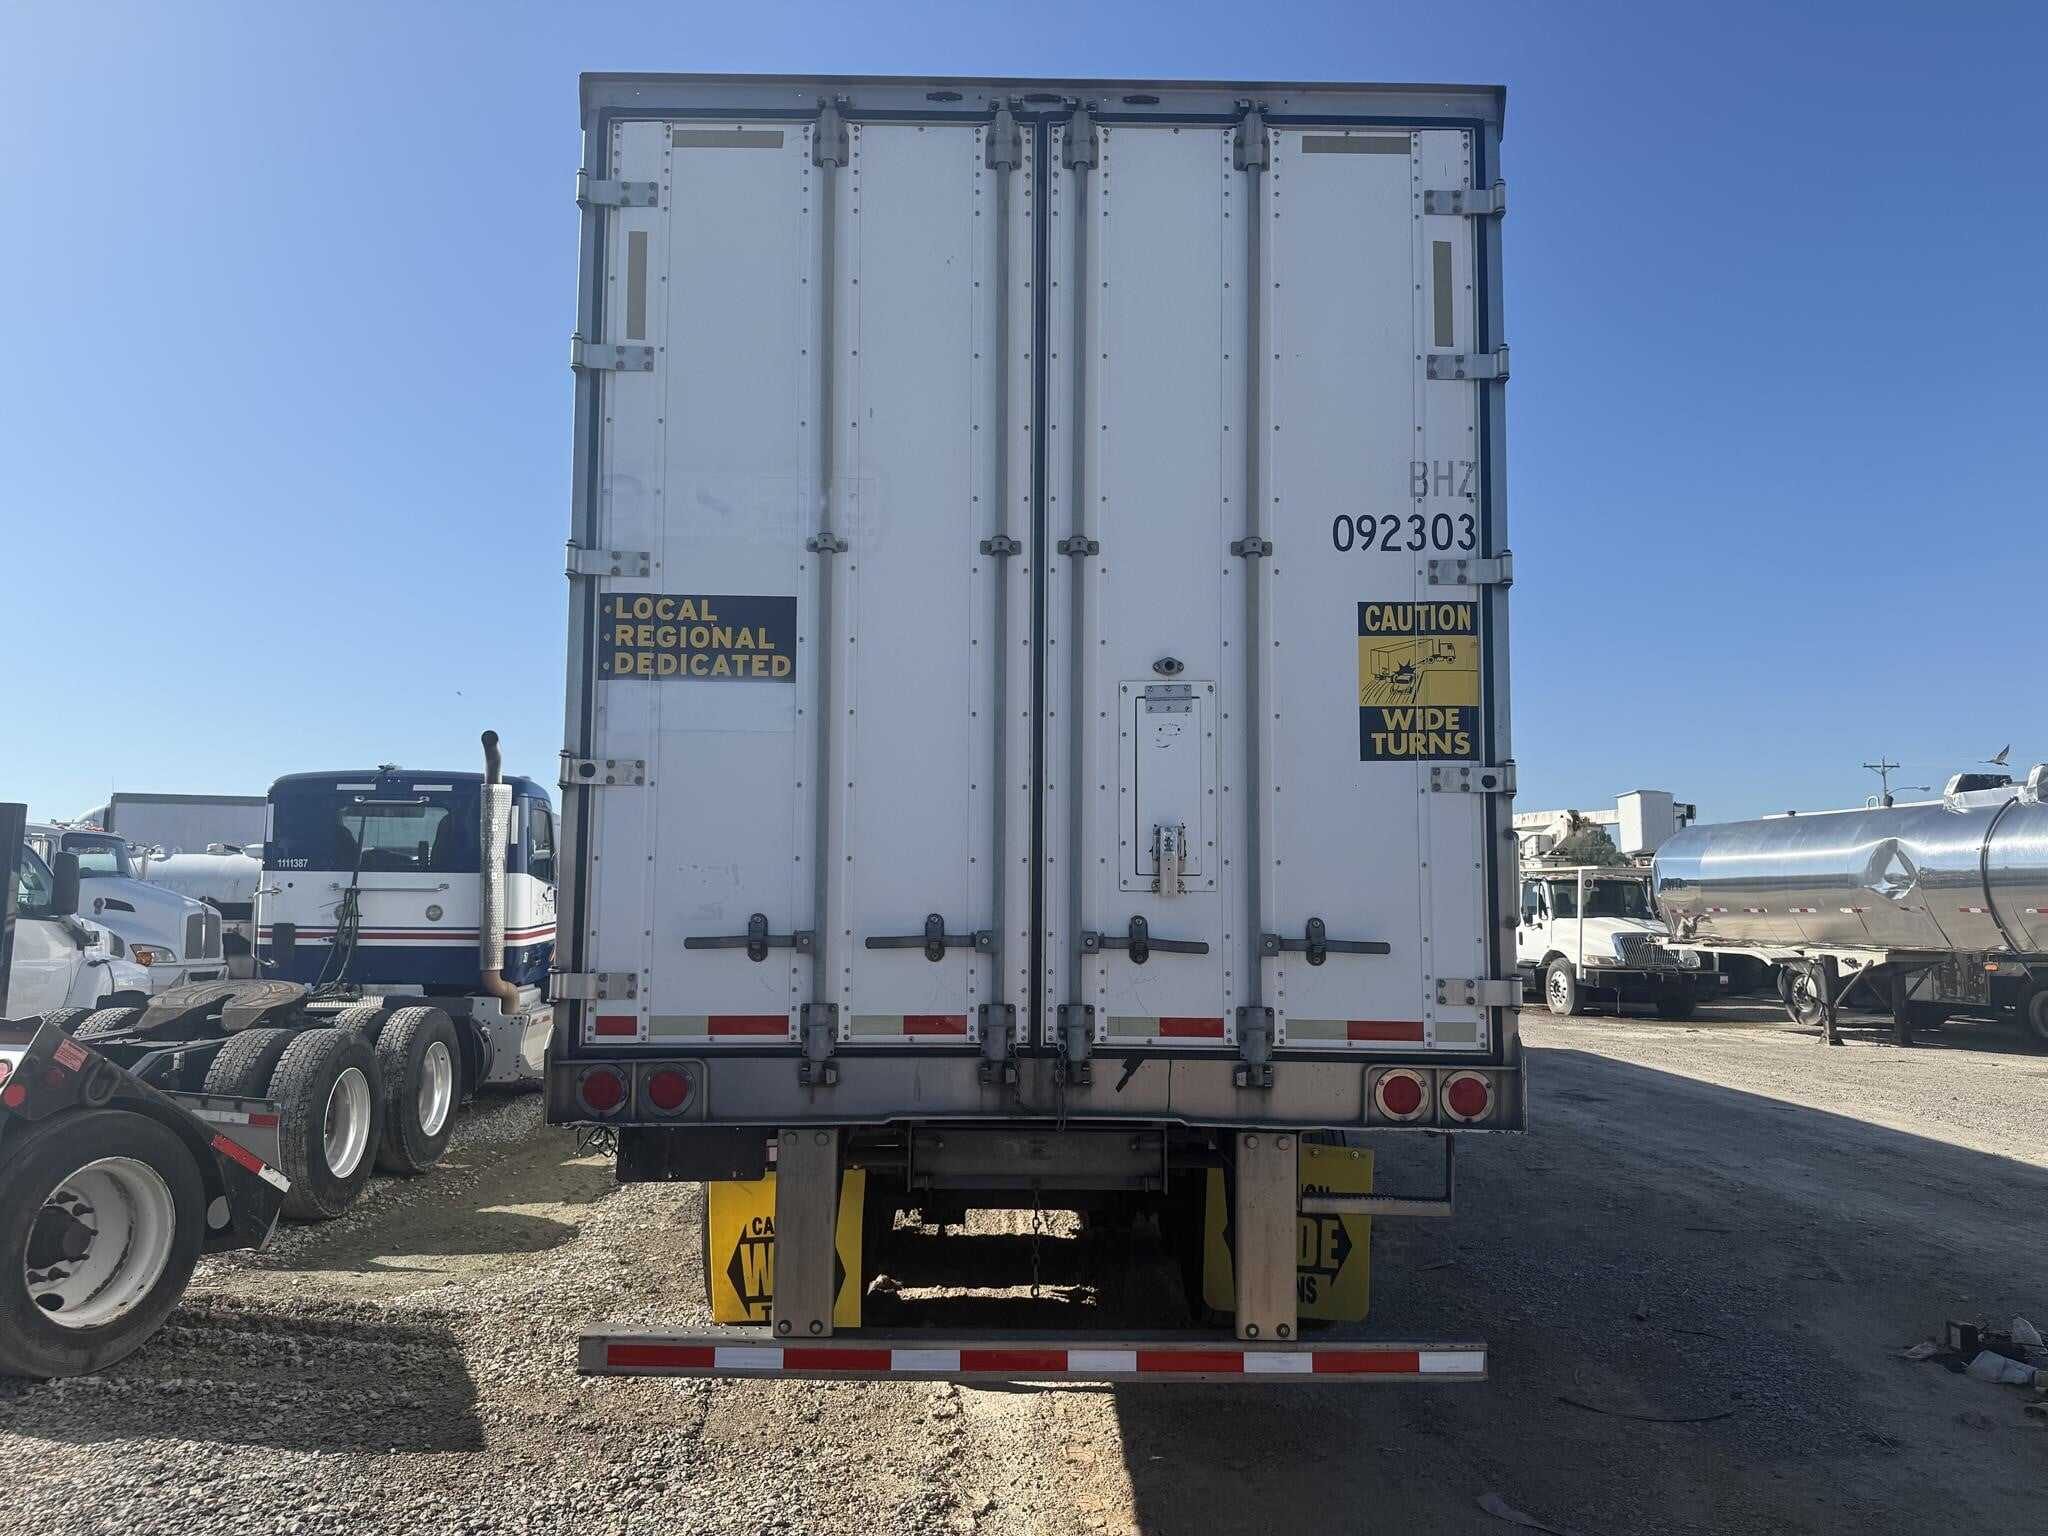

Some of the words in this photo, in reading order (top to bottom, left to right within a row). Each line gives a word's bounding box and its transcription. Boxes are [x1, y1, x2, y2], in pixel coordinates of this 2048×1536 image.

[1332, 512, 1477, 552] 092303
[615, 596, 718, 621] LOCAL
[1364, 604, 1472, 632] CAUTION
[614, 624, 776, 650] REGIONAL
[613, 651, 792, 678] DEDICATED
[1381, 707, 1460, 732] WIDE
[1371, 731, 1471, 756] TURNS
